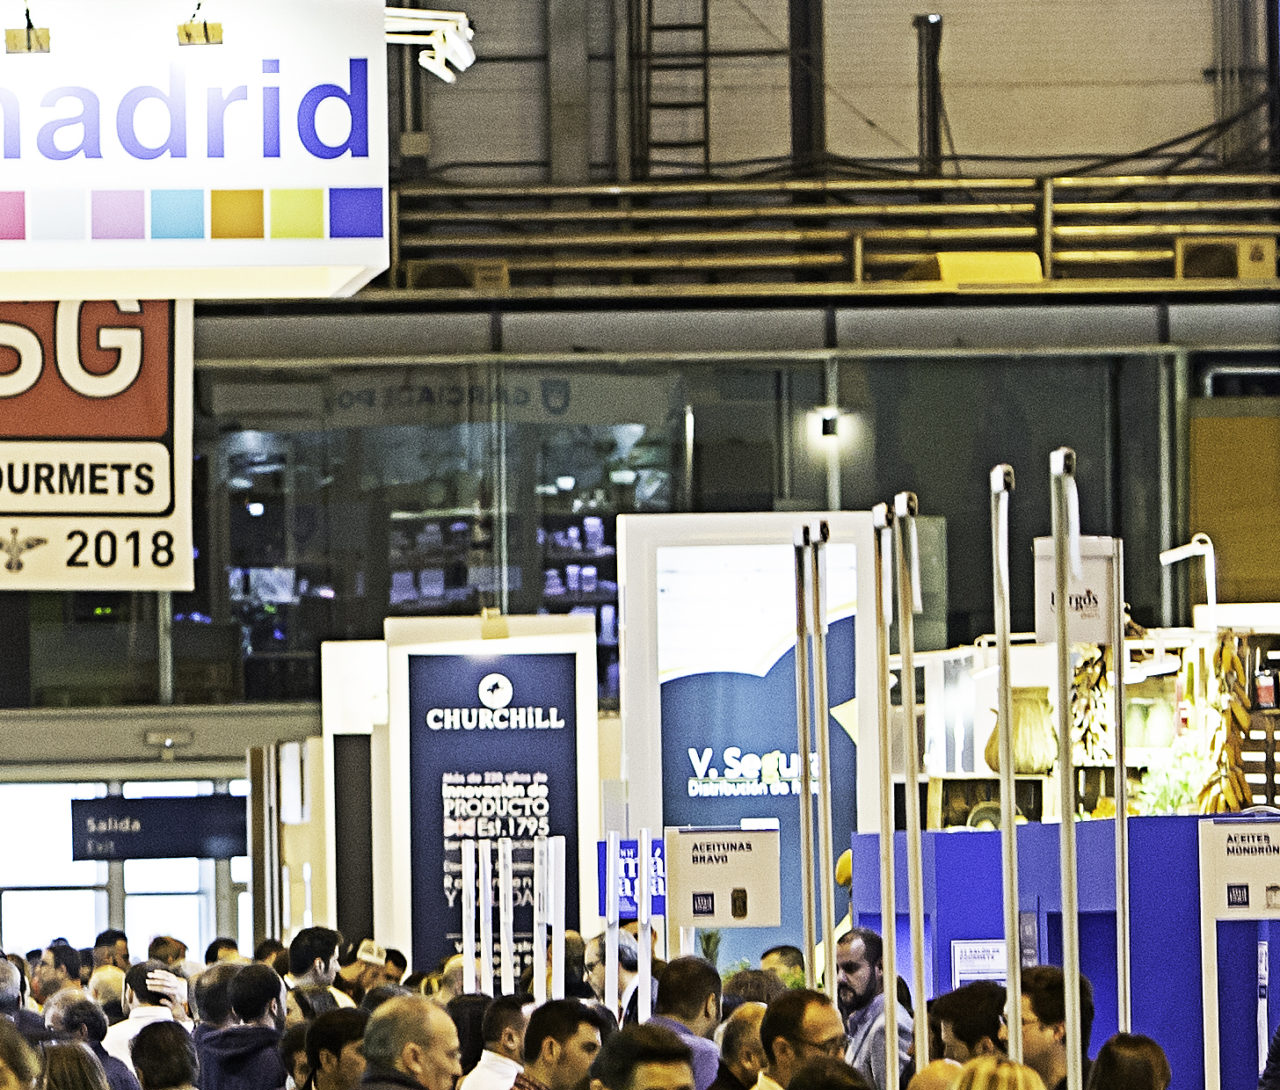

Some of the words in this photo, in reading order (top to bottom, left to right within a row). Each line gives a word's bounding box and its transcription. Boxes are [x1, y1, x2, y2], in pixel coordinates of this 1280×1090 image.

[65, 529, 176, 569] 2018
[426, 706, 566, 731] CHURCHILL
[687, 747, 719, 779] V.
[723, 746, 820, 785] Segua
[526, 782, 550, 798] de
[443, 797, 550, 818] PRODUCTO
[87, 818, 141, 832] Salida
[1226, 833, 1271, 844] ACEITES
[691, 841, 753, 853] ACEITUNAS
[691, 854, 729, 865] BRAVO
